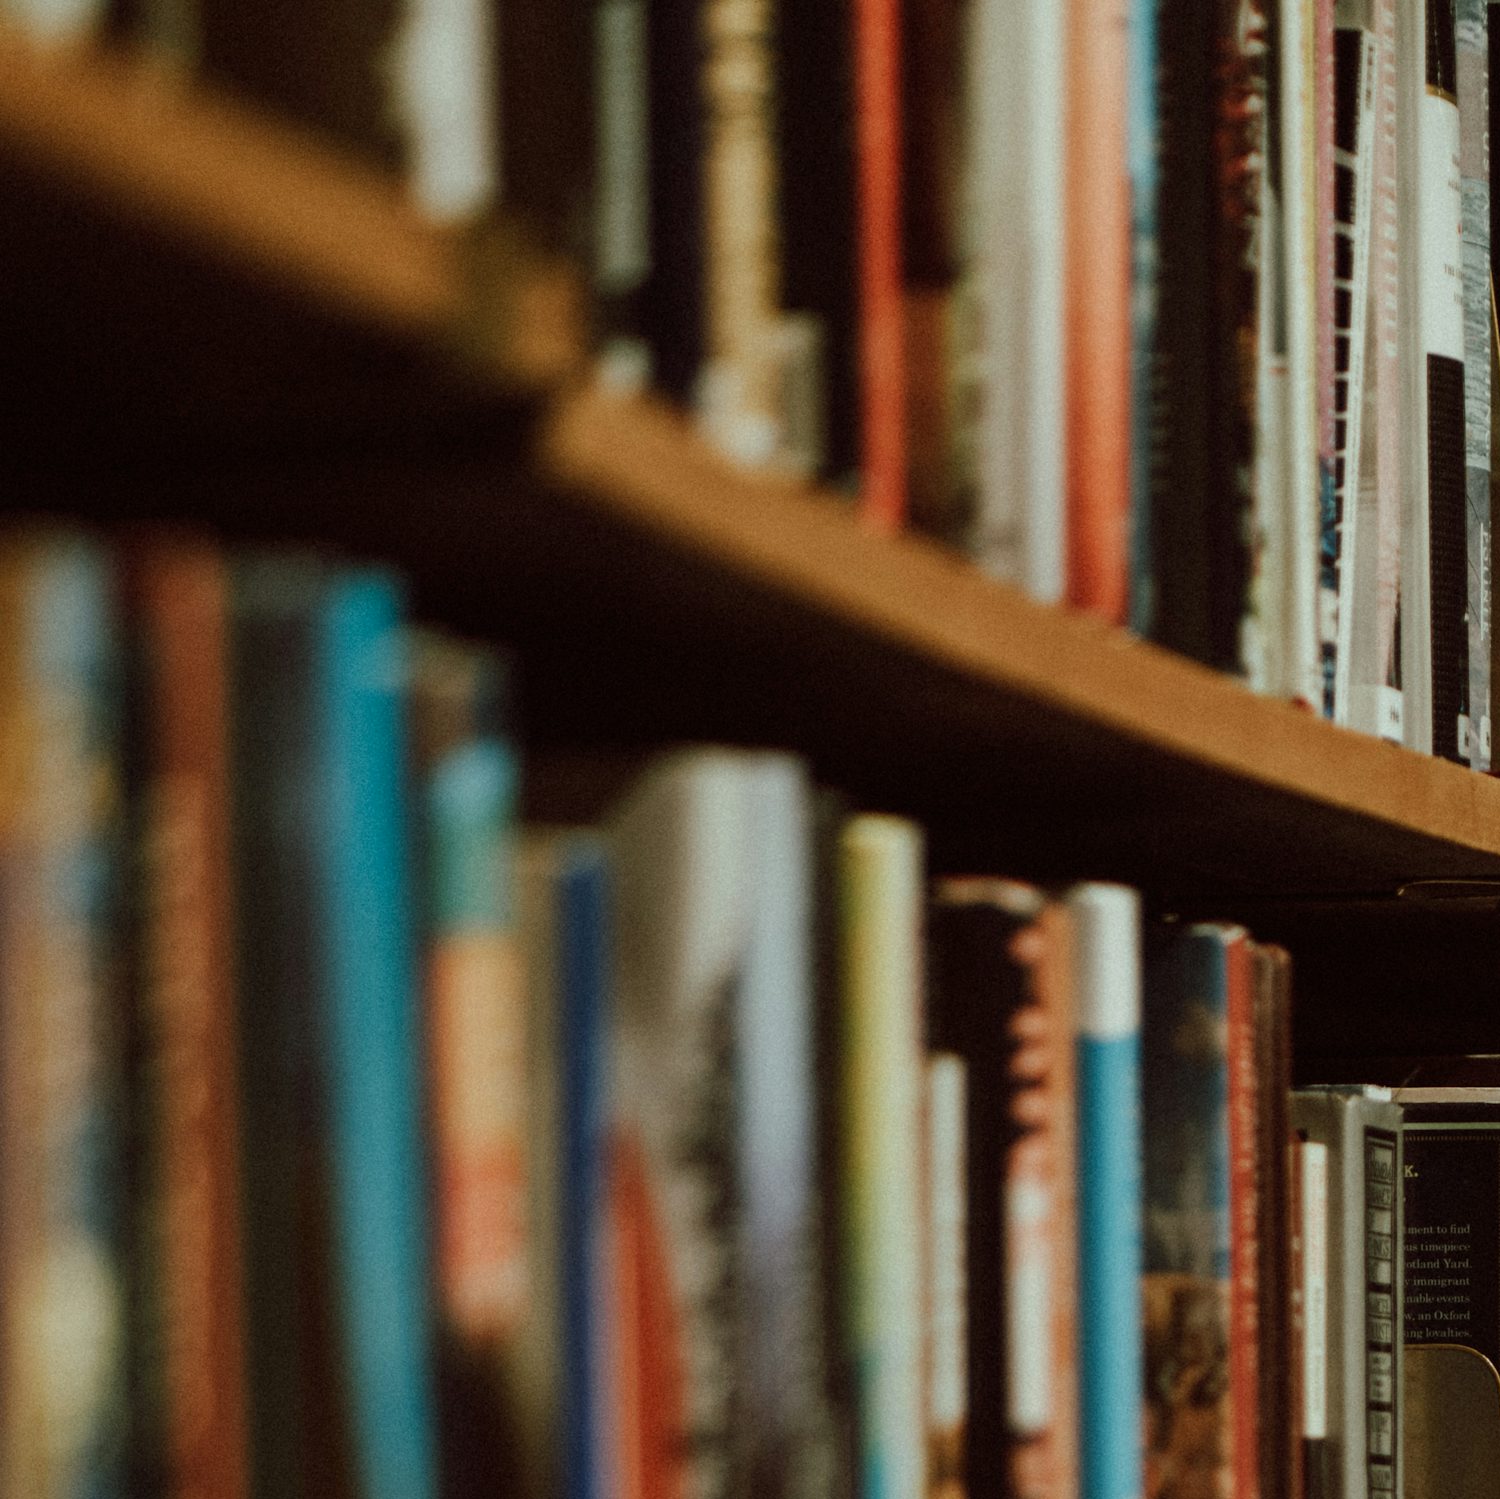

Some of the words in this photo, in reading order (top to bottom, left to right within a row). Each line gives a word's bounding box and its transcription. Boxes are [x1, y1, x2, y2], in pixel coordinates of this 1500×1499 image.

[1436, 1225, 1448, 1234] to
[1450, 1224, 1471, 1234] find
[1420, 1241, 1471, 1254] timepiece
[1443, 1257, 1472, 1269] Yard.
[1413, 1276, 1471, 1288] immigrant
[1437, 1293, 1471, 1304] events
[1418, 1311, 1431, 1321] an
[1434, 1309, 1471, 1321] Oxford
[1425, 1326, 1473, 1339] loyalties.
